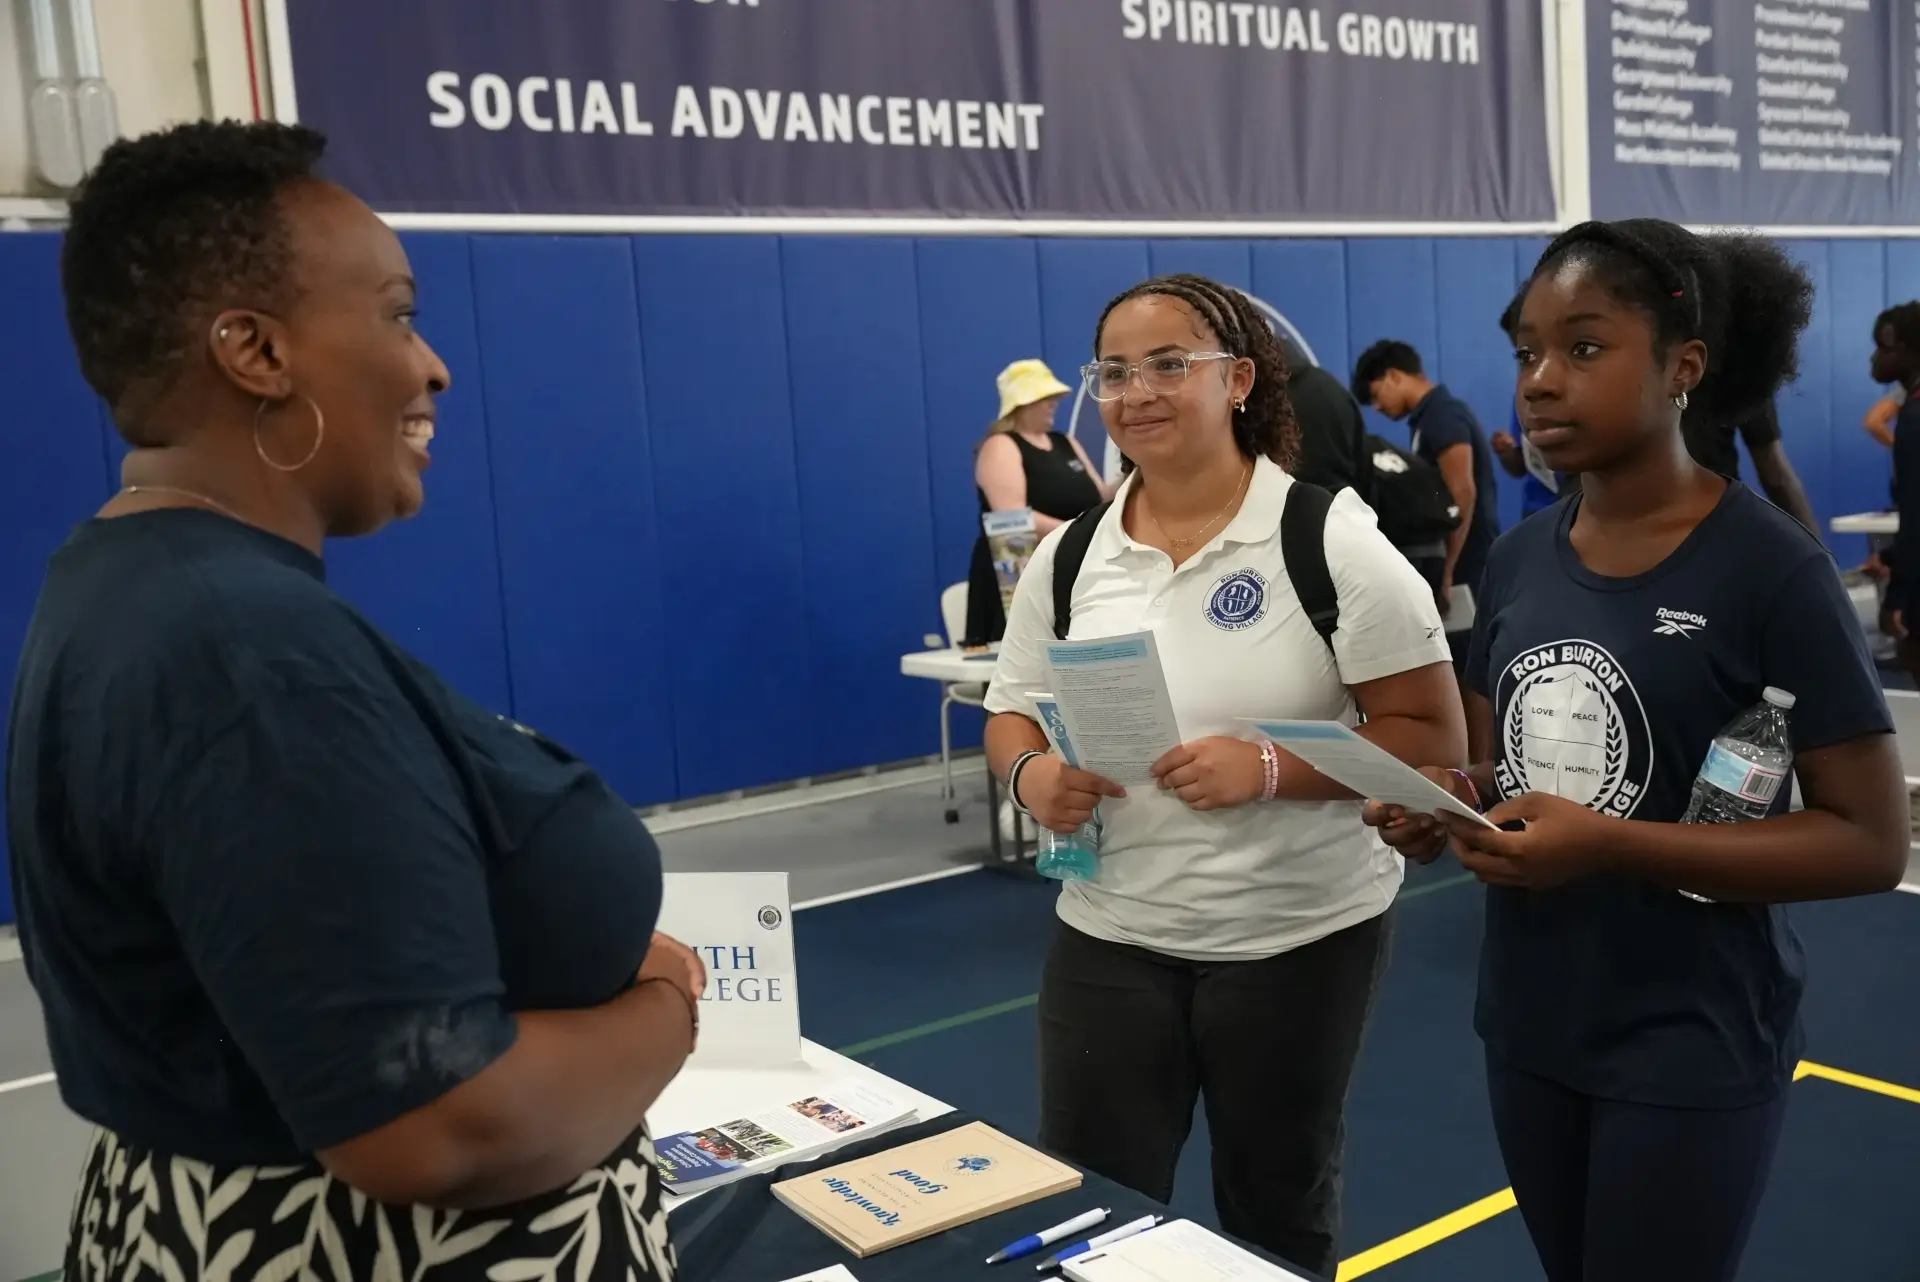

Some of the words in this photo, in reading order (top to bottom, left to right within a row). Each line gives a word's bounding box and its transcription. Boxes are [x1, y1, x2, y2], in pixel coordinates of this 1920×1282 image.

[1121, 0, 1330, 53] SPIRITUAL
[1336, 12, 1479, 65] GROWTH
[425, 70, 655, 136] SOCIAL
[670, 84, 1044, 151] ADVANCEMENT
[1220, 572, 1238, 584] RON
[1238, 568, 1267, 587] URTO
[1204, 607, 1234, 630] TRAINING
[1235, 608, 1265, 630] VILLAGE
[1655, 607, 1708, 627] Reebok
[1511, 648, 1556, 681] RON
[1561, 645, 1624, 693] BURTON
[1531, 706, 1555, 717] LOVE
[1572, 712, 1599, 722] PEACE
[1527, 757, 1556, 770] PATIENCE
[888, 1169, 949, 1194] Good
[822, 1177, 902, 1227] Knowledge
